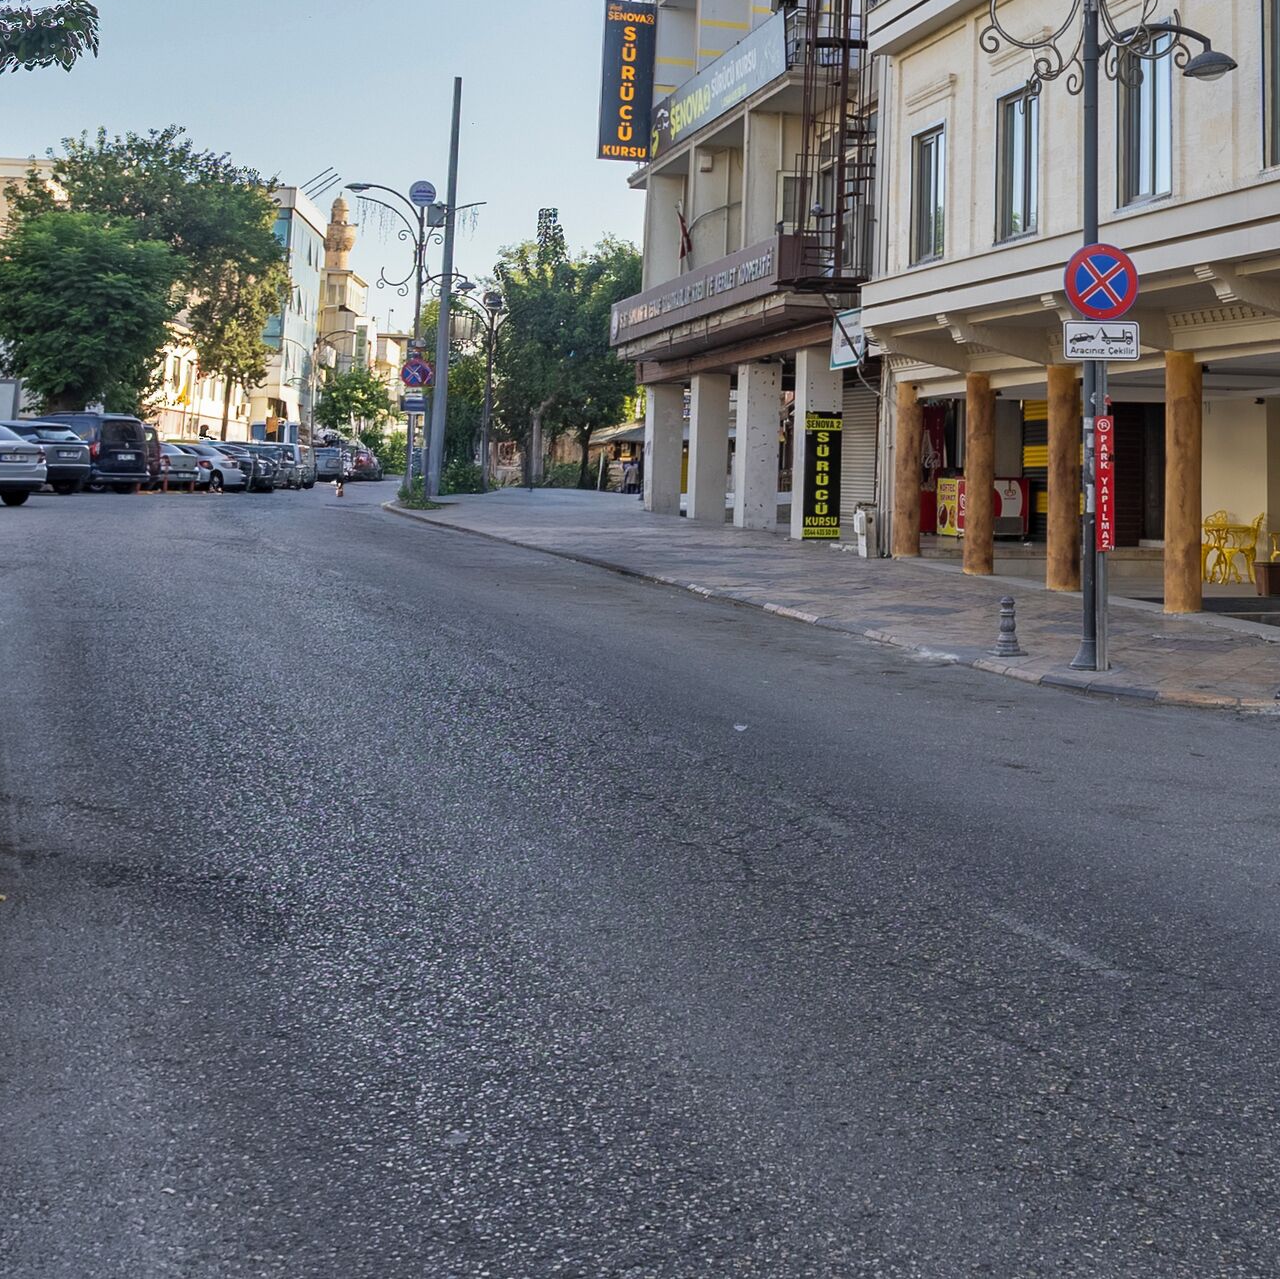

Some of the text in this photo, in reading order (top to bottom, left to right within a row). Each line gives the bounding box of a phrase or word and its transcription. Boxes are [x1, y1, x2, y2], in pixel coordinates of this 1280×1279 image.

[617, 26, 637, 141] SÜRÜCÜ
[602, 145, 646, 158] KURSU
[1070, 346, 1135, 355] Aracınız Çekilir
[1100, 434, 1109, 469] PARK
[815, 432, 830, 515] SÜRÜCÜ
[805, 516, 838, 526] KURSU
[1101, 477, 1110, 548] YAPILMAZ
